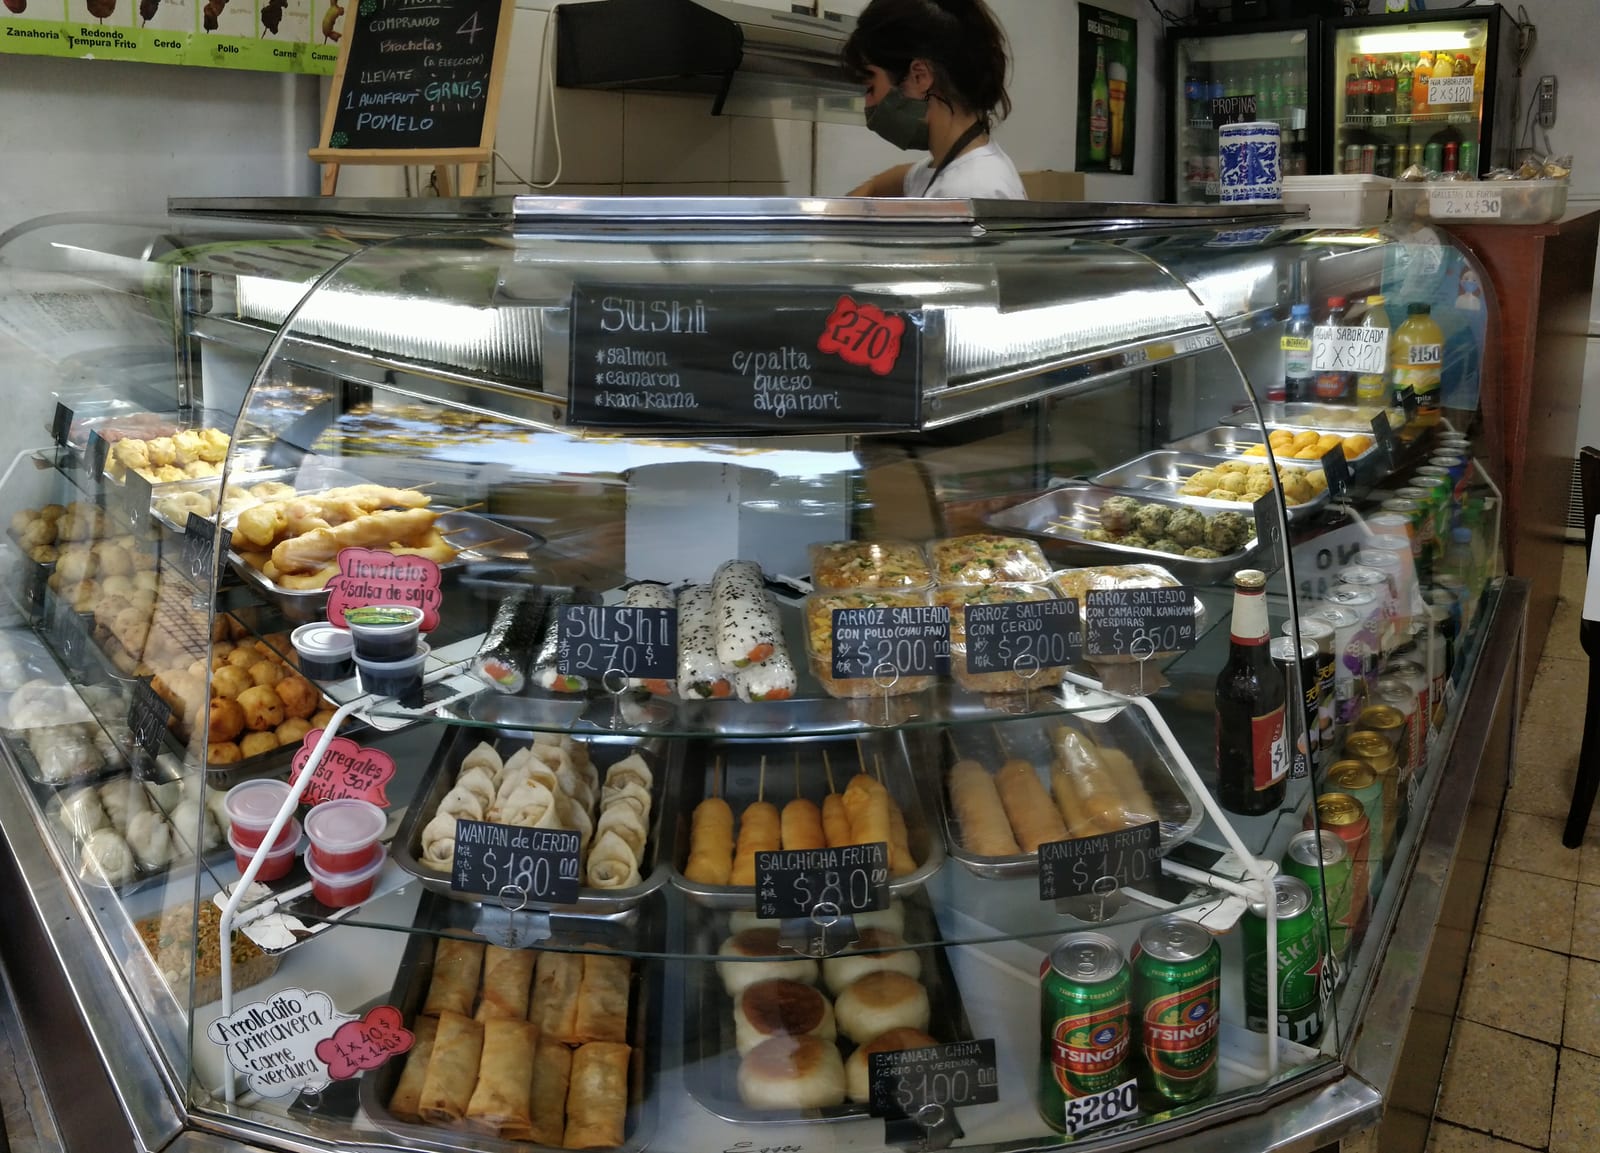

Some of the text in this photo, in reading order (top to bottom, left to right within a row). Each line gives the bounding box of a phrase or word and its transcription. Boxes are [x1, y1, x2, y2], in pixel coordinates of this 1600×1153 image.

[6, 27, 60, 40] Zanahoria
[81, 28, 124, 39] Redondo
[370, 11, 484, 44] COMPRANDO 4
[69, 36, 137, 49] Tempura Frito
[154, 39, 182, 49] Cerdo
[217, 44, 240, 54] Pollo
[380, 37, 442, 53] Brochetas
[273, 49, 298, 58] Carne
[345, 91, 354, 110] 1
[1430, 86, 1437, 102] 2
[1448, 86, 1471, 102] $120
[1212, 96, 1257, 115] PROPINAS
[356, 112, 433, 132] POMELO
[1446, 200, 1454, 213] 2
[1473, 199, 1500, 215] $30
[832, 310, 891, 360] 270
[1336, 328, 1384, 342] SABORIZADA
[607, 346, 669, 366] salmon
[1315, 342, 1326, 369] 2
[1347, 343, 1382, 371] $120
[1410, 346, 1441, 363] $150
[606, 369, 681, 389] camaron
[753, 374, 812, 395] queso
[799, 391, 842, 411] nori
[347, 558, 428, 583] Llevatelos
[386, 584, 401, 600] de
[405, 583, 434, 610] soja
[1087, 590, 1187, 606] ARROZ SALTEADO
[838, 606, 951, 626] ARROZ SALTEADO
[969, 601, 1075, 622] ARROZ SALTEADO
[1086, 607, 1105, 618] CON
[836, 624, 947, 640] CON POLLO (CHAU FAN)
[969, 619, 1044, 636] CON CERDO
[1086, 617, 1146, 629] Y VERDURAS
[459, 823, 579, 853] WANTAN de CERDO
[216, 997, 302, 1041] Arrolladito
[235, 1011, 323, 1060] primavera
[876, 1048, 939, 1066] EMPANADA
[930, 1058, 977, 1071] VERDURA
[1067, 1083, 1137, 1133] $280
